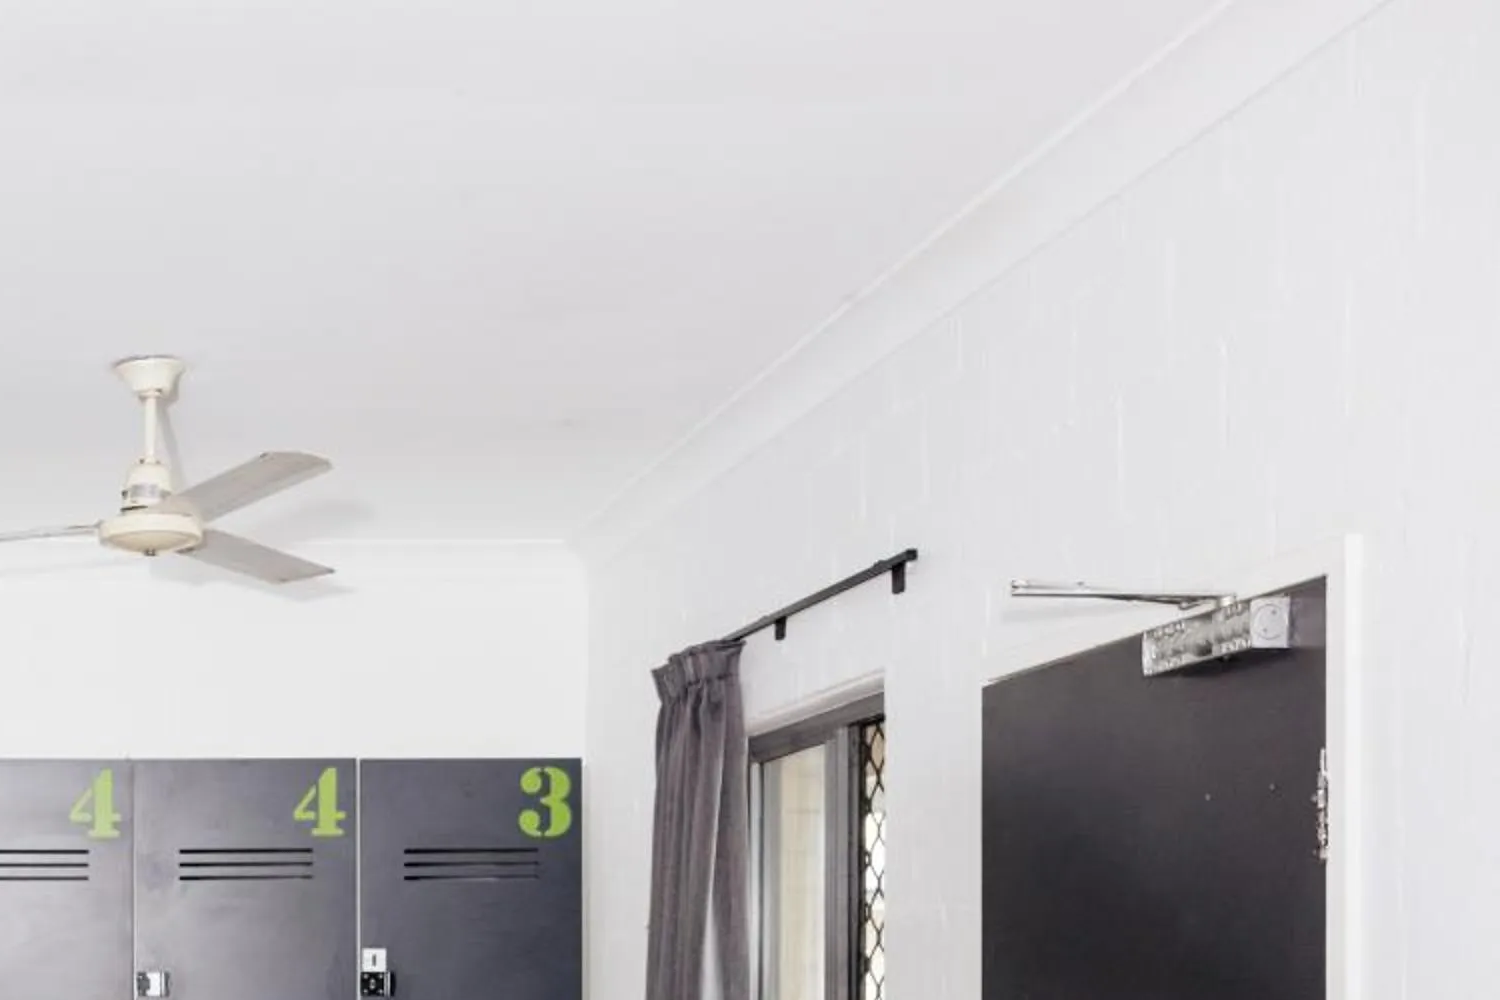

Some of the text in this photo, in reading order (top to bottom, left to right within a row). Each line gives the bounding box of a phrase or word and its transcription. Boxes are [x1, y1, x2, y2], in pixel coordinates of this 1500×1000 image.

[69, 768, 121, 839] 4
[293, 767, 346, 837] 4
[518, 766, 572, 838] 3
